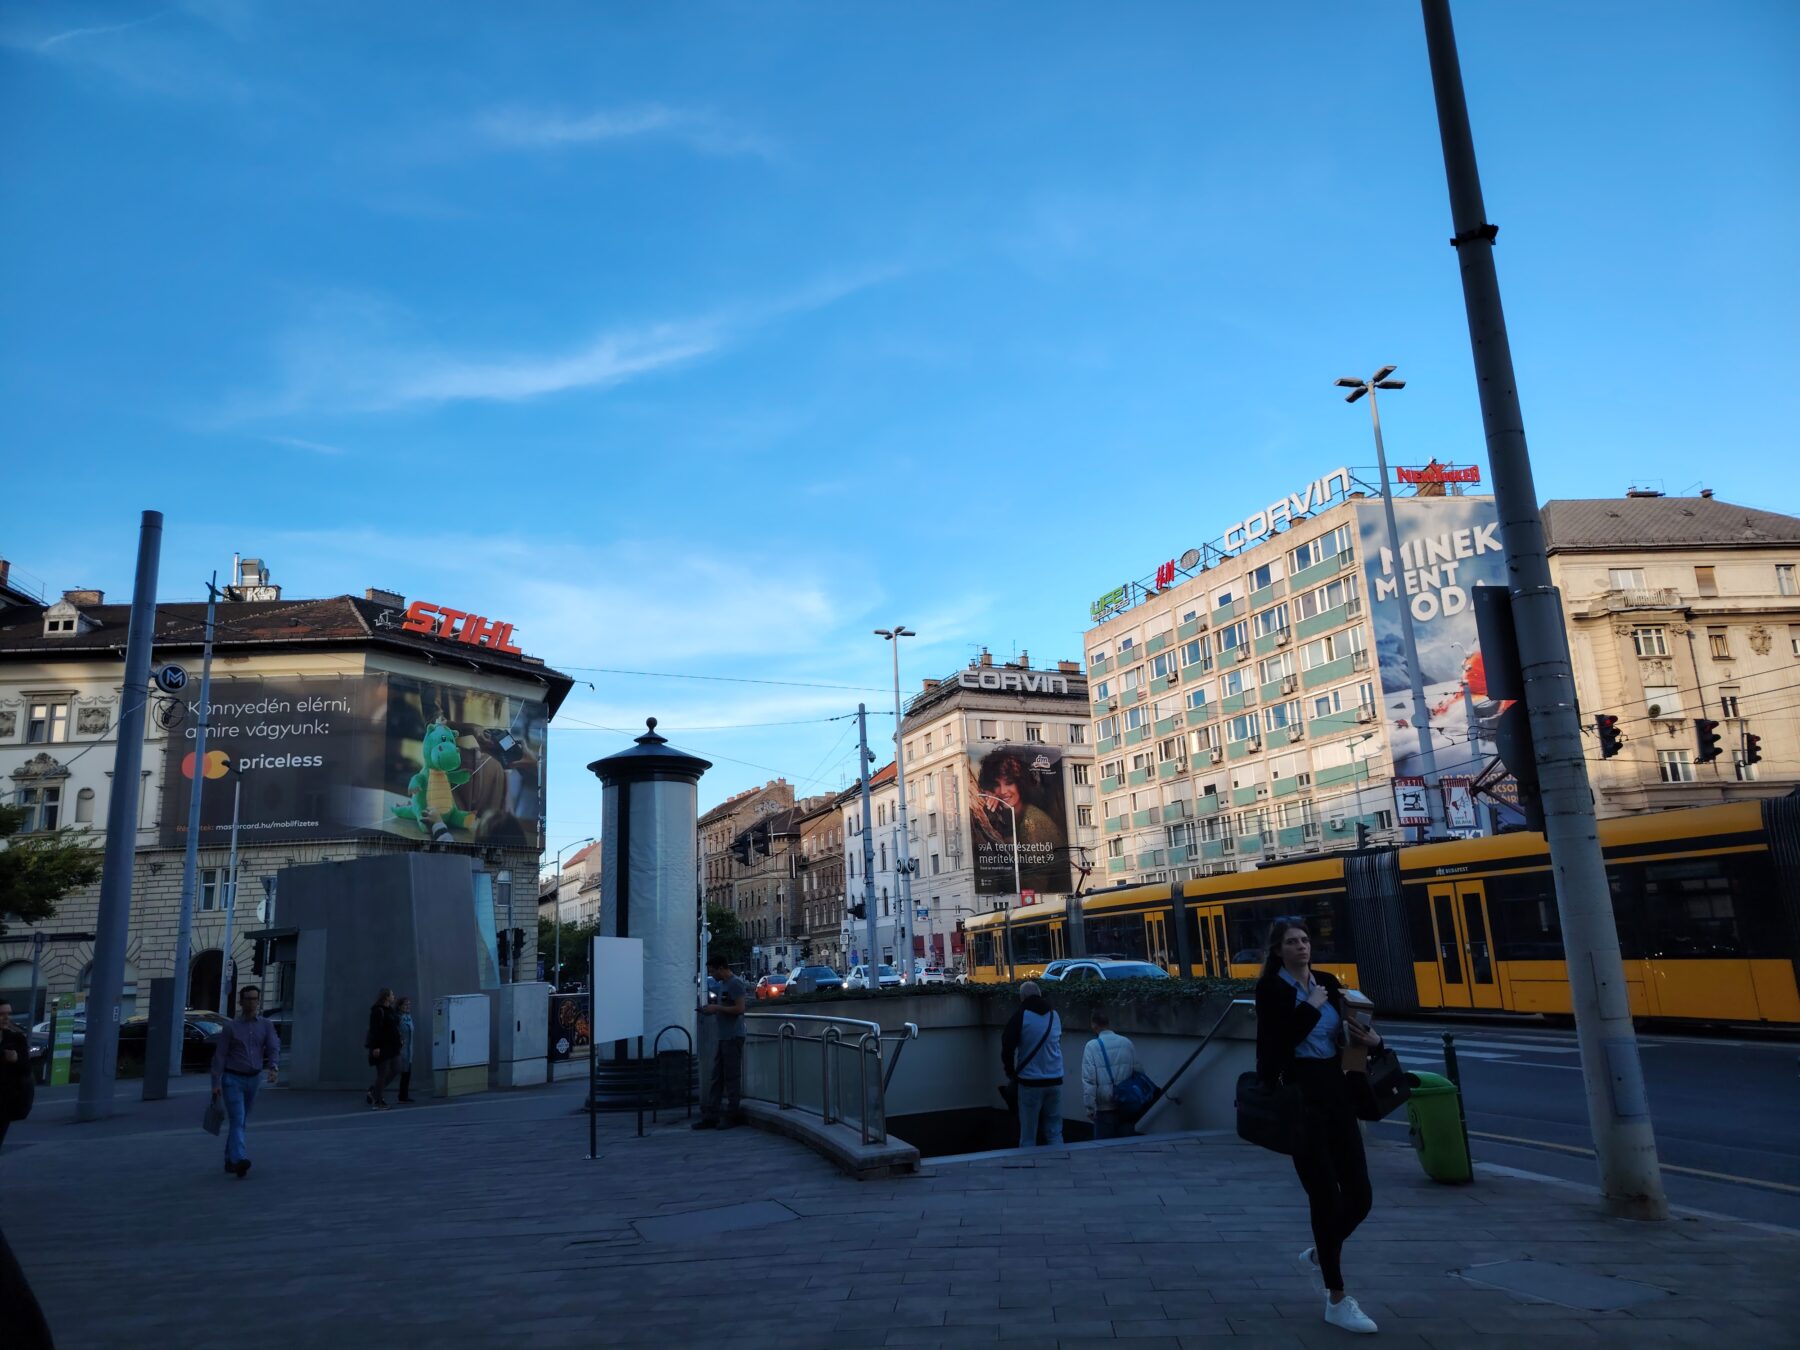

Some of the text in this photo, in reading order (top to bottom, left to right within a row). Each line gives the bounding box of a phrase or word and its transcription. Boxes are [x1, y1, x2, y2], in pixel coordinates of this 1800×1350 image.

[1223, 467, 1350, 552] CORVIN
[1380, 522, 1503, 576] MINEK
[1375, 561, 1460, 602] MENT
[1411, 579, 1486, 621] OD
[402, 601, 522, 656] STIHL
[959, 670, 1068, 694] CORVIN
[297, 697, 351, 714] elérni,
[246, 719, 330, 740] vágyunk:
[239, 753, 323, 772] priceless
